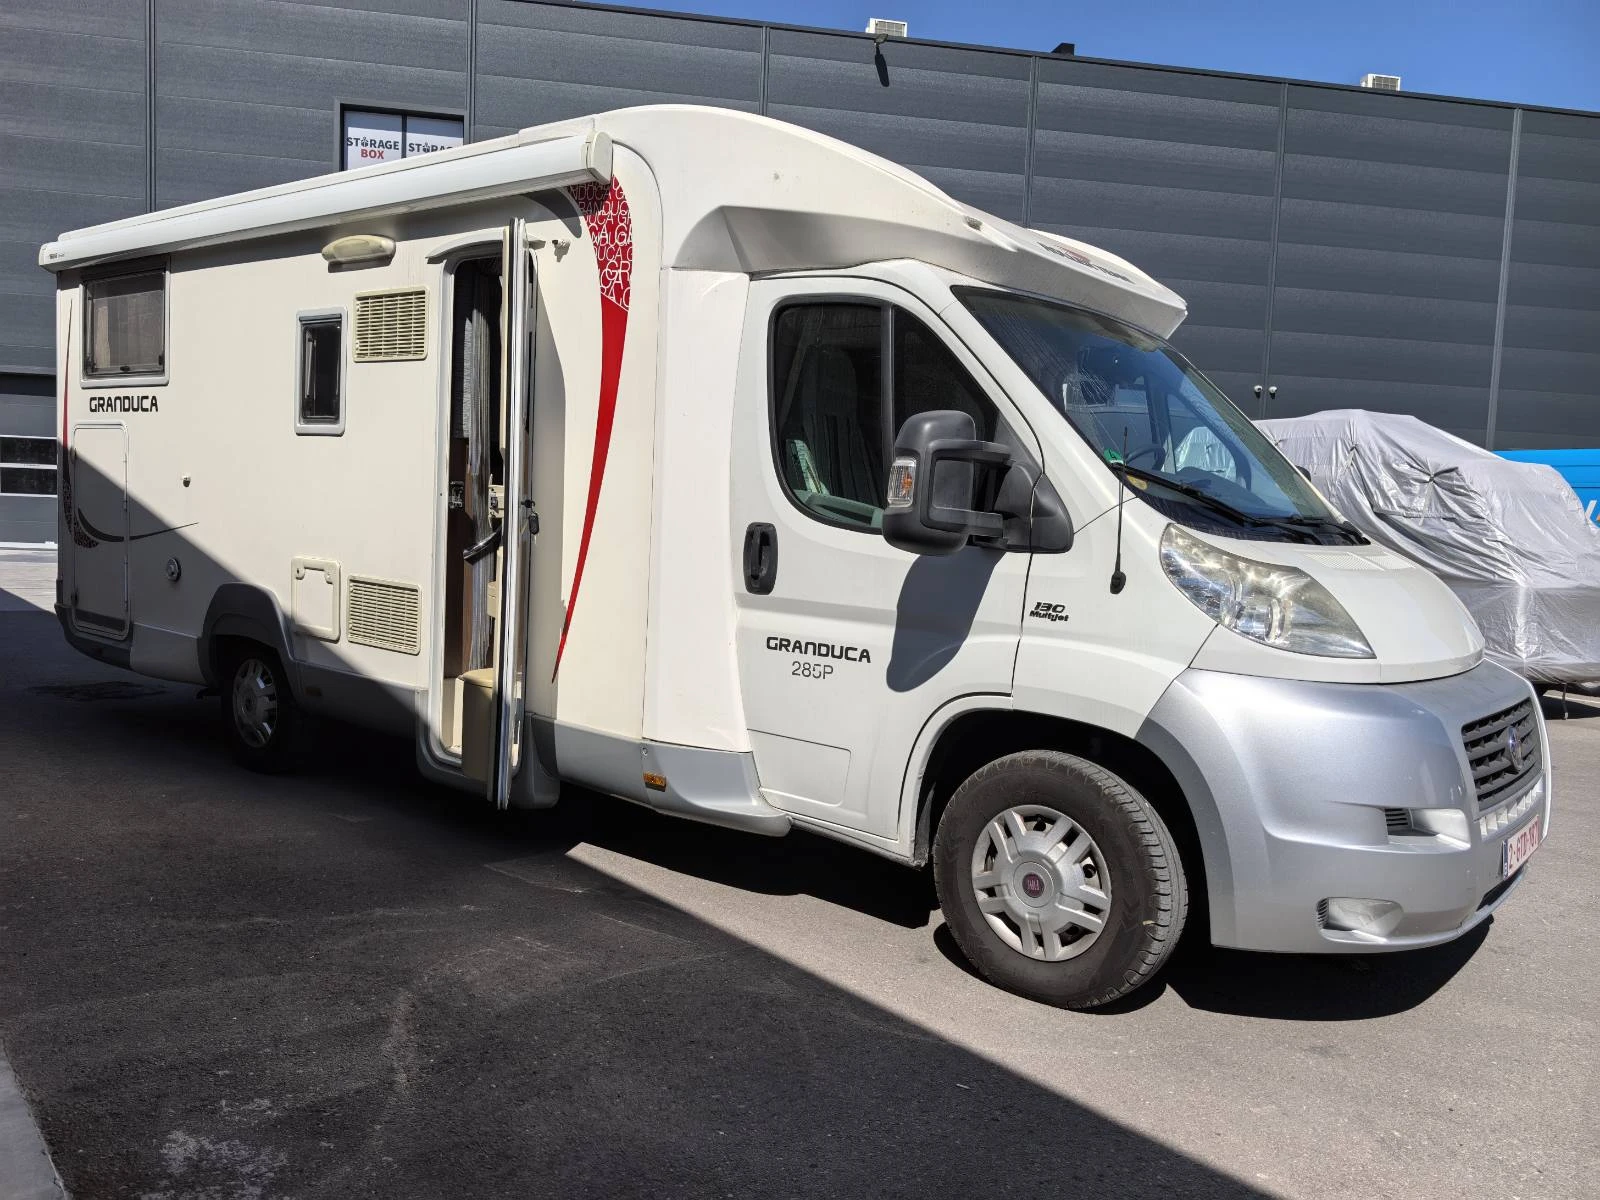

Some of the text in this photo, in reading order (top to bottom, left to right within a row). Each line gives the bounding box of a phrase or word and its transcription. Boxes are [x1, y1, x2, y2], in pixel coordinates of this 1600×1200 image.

[360, 149, 385, 160] BOX
[89, 395, 159, 413] GRANDUCA
[1034, 601, 1066, 614] 130
[766, 636, 871, 664] GRANDUCA
[791, 660, 834, 680] 285P
